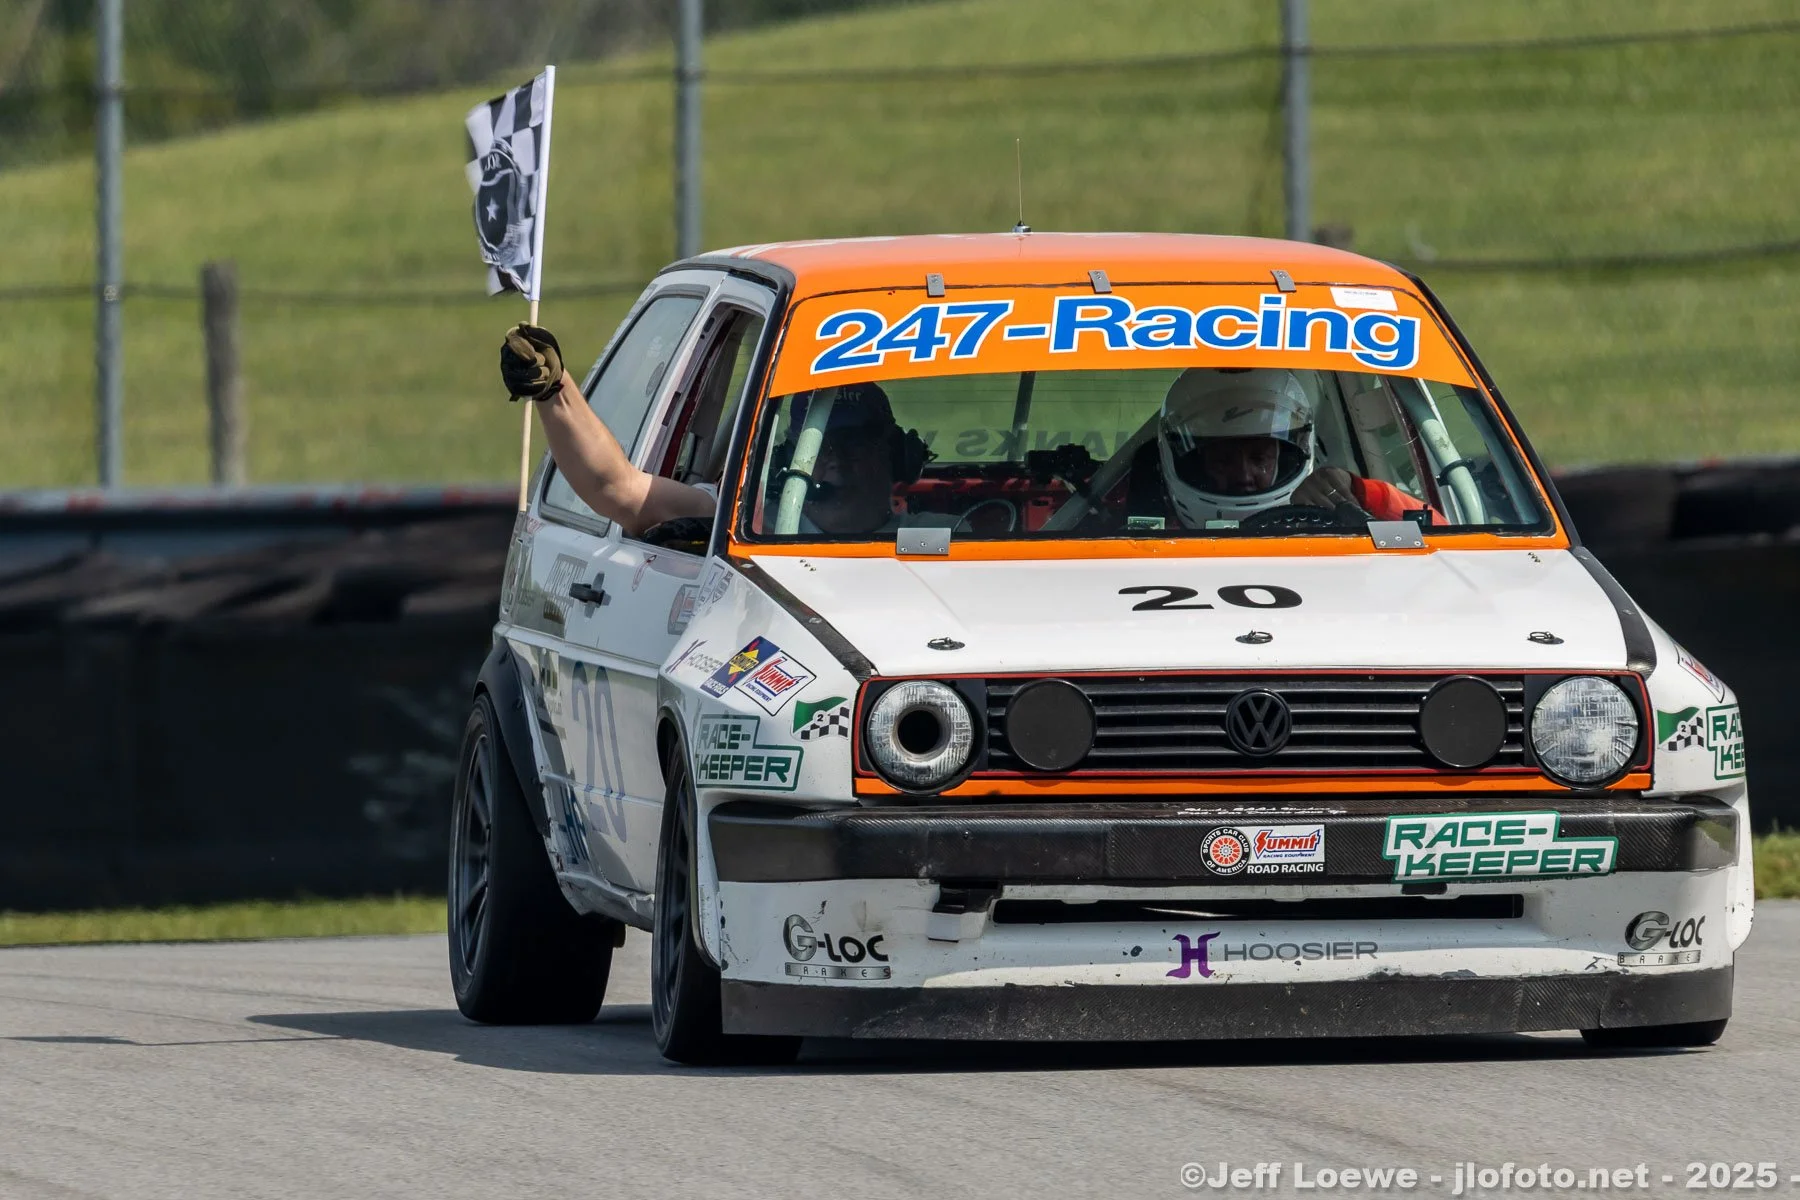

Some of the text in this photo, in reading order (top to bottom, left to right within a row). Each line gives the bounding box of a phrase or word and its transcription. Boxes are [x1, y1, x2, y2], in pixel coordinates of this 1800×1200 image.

[810, 293, 1421, 374] 247-Racing
[1118, 584, 1303, 611] 20
[816, 713, 824, 722] 2
[1680, 724, 1687, 733] 2
[572, 660, 627, 843] 20
[699, 753, 792, 783] KEEPER
[1222, 828, 1239, 836] CAR
[1238, 833, 1250, 853] CLUB
[1394, 820, 1548, 849] RACE-
[1206, 858, 1248, 874] OF AMERICA
[1247, 863, 1324, 874] ROAD RACING
[1404, 848, 1607, 877] KEEPER
[783, 914, 889, 963] G-LOC
[1224, 941, 1379, 961] HOOSIER
